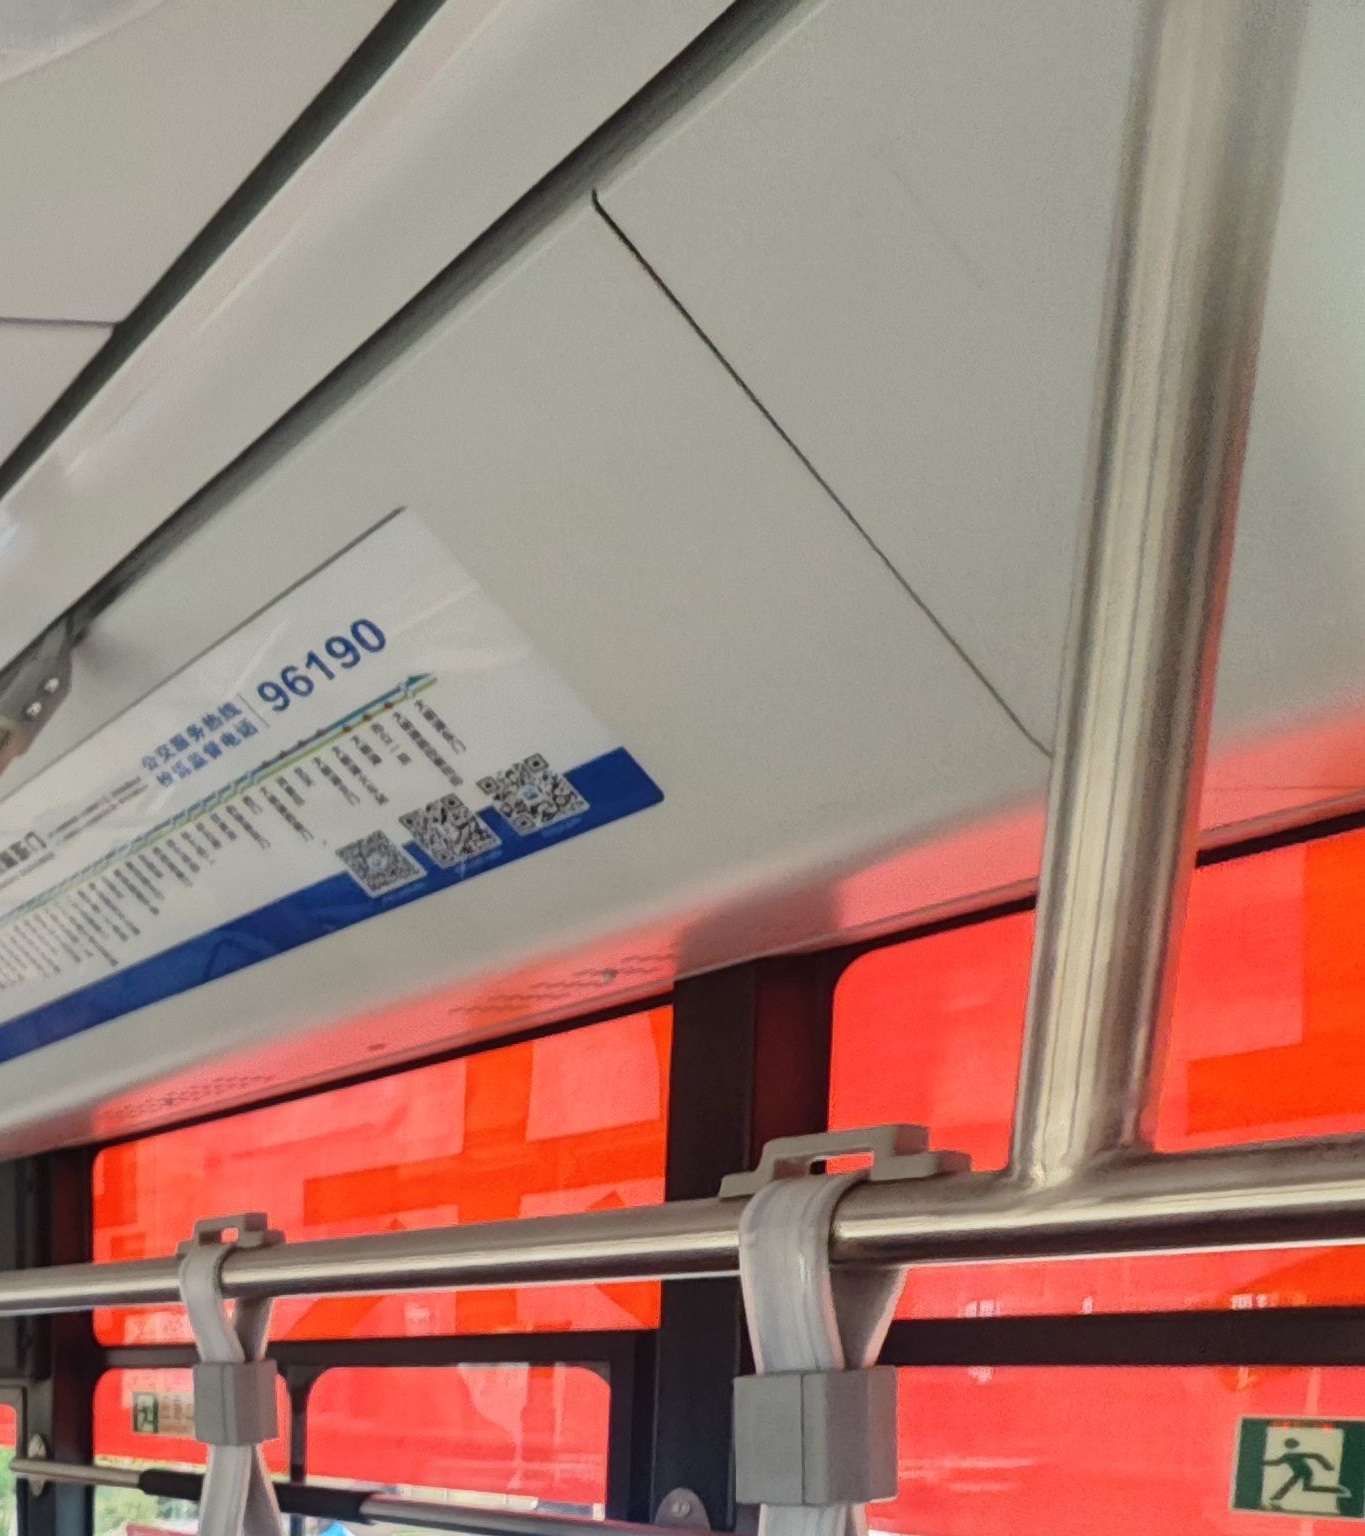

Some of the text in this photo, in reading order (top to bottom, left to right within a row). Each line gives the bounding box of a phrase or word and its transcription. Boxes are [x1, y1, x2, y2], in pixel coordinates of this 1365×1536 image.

[257, 617, 387, 714] 96190
[141, 700, 243, 772] 公交服务热线
